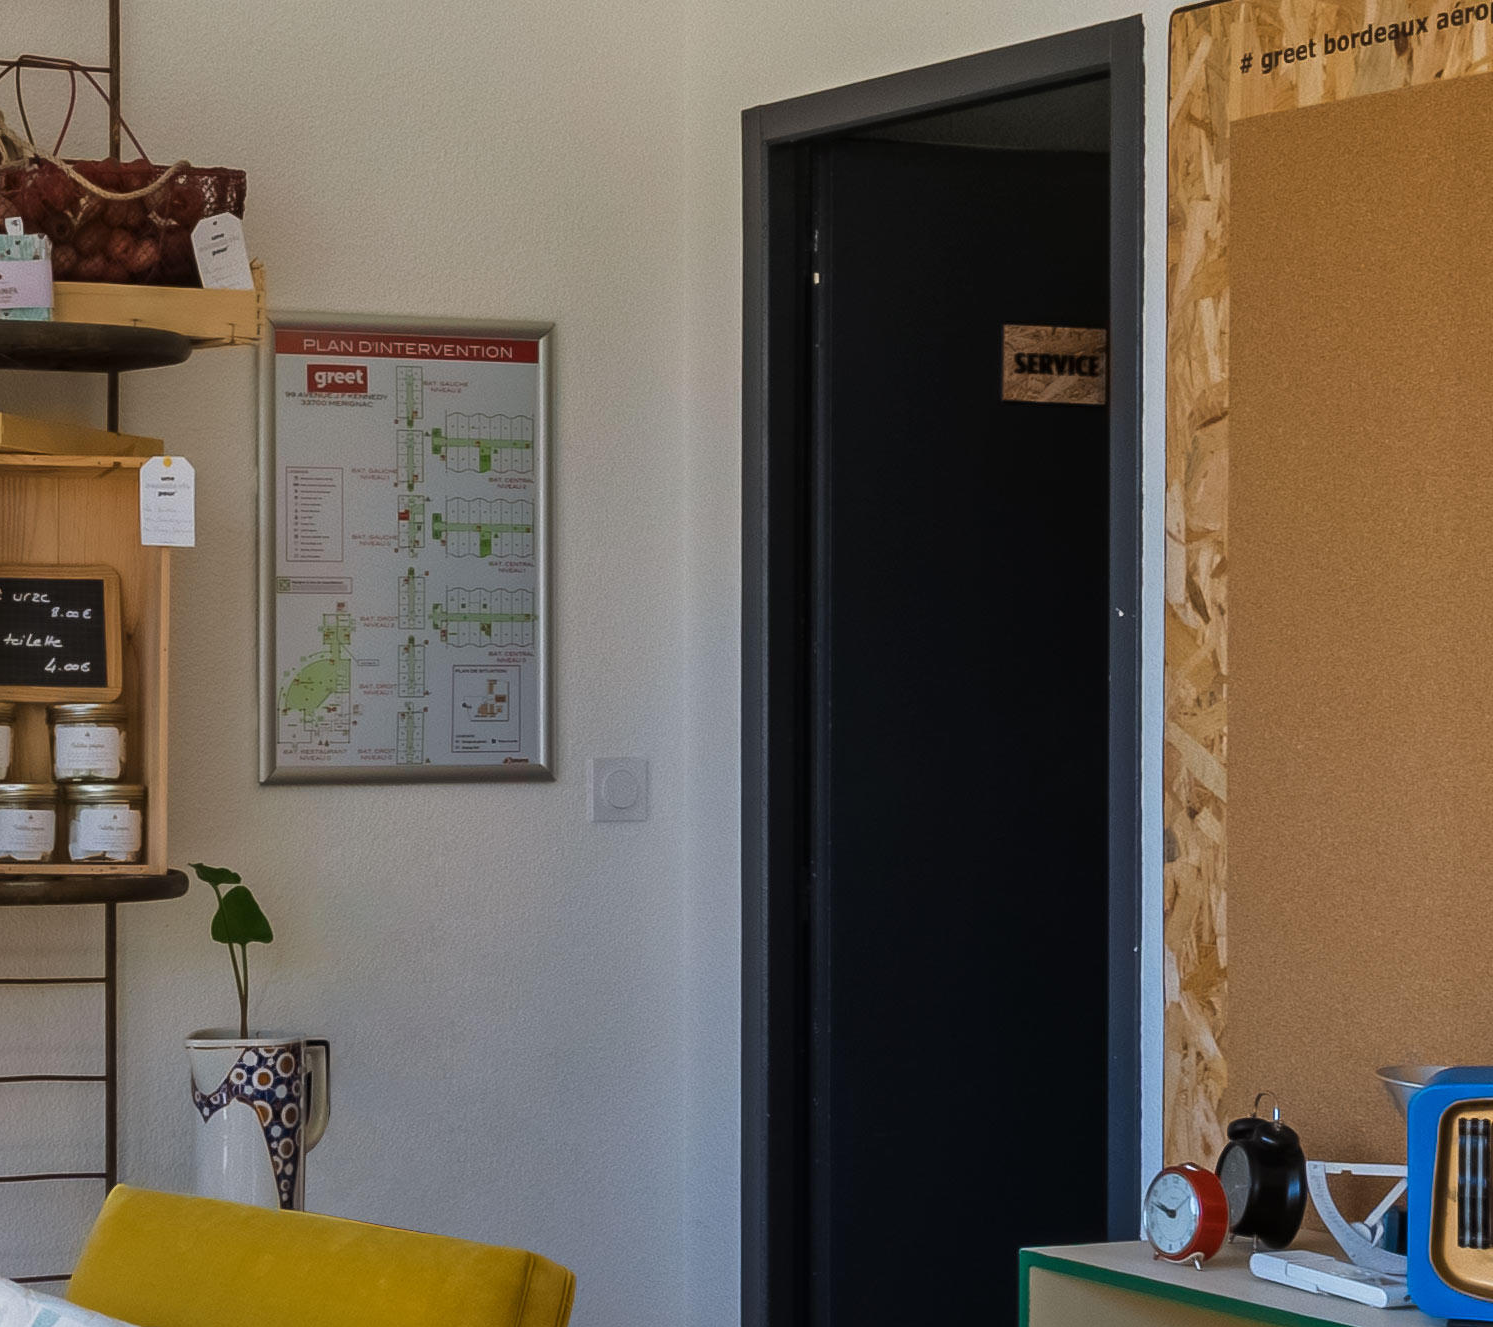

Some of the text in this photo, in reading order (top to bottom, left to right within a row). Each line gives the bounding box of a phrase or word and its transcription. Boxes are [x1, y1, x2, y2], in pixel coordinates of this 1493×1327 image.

[1260, 40, 1316, 73] greet
[1324, 18, 1429, 55] bordeaux
[303, 339, 513, 359] PLAN D'INTERVENTION
[1014, 352, 1100, 377] SERVICE
[314, 369, 364, 389] greet
